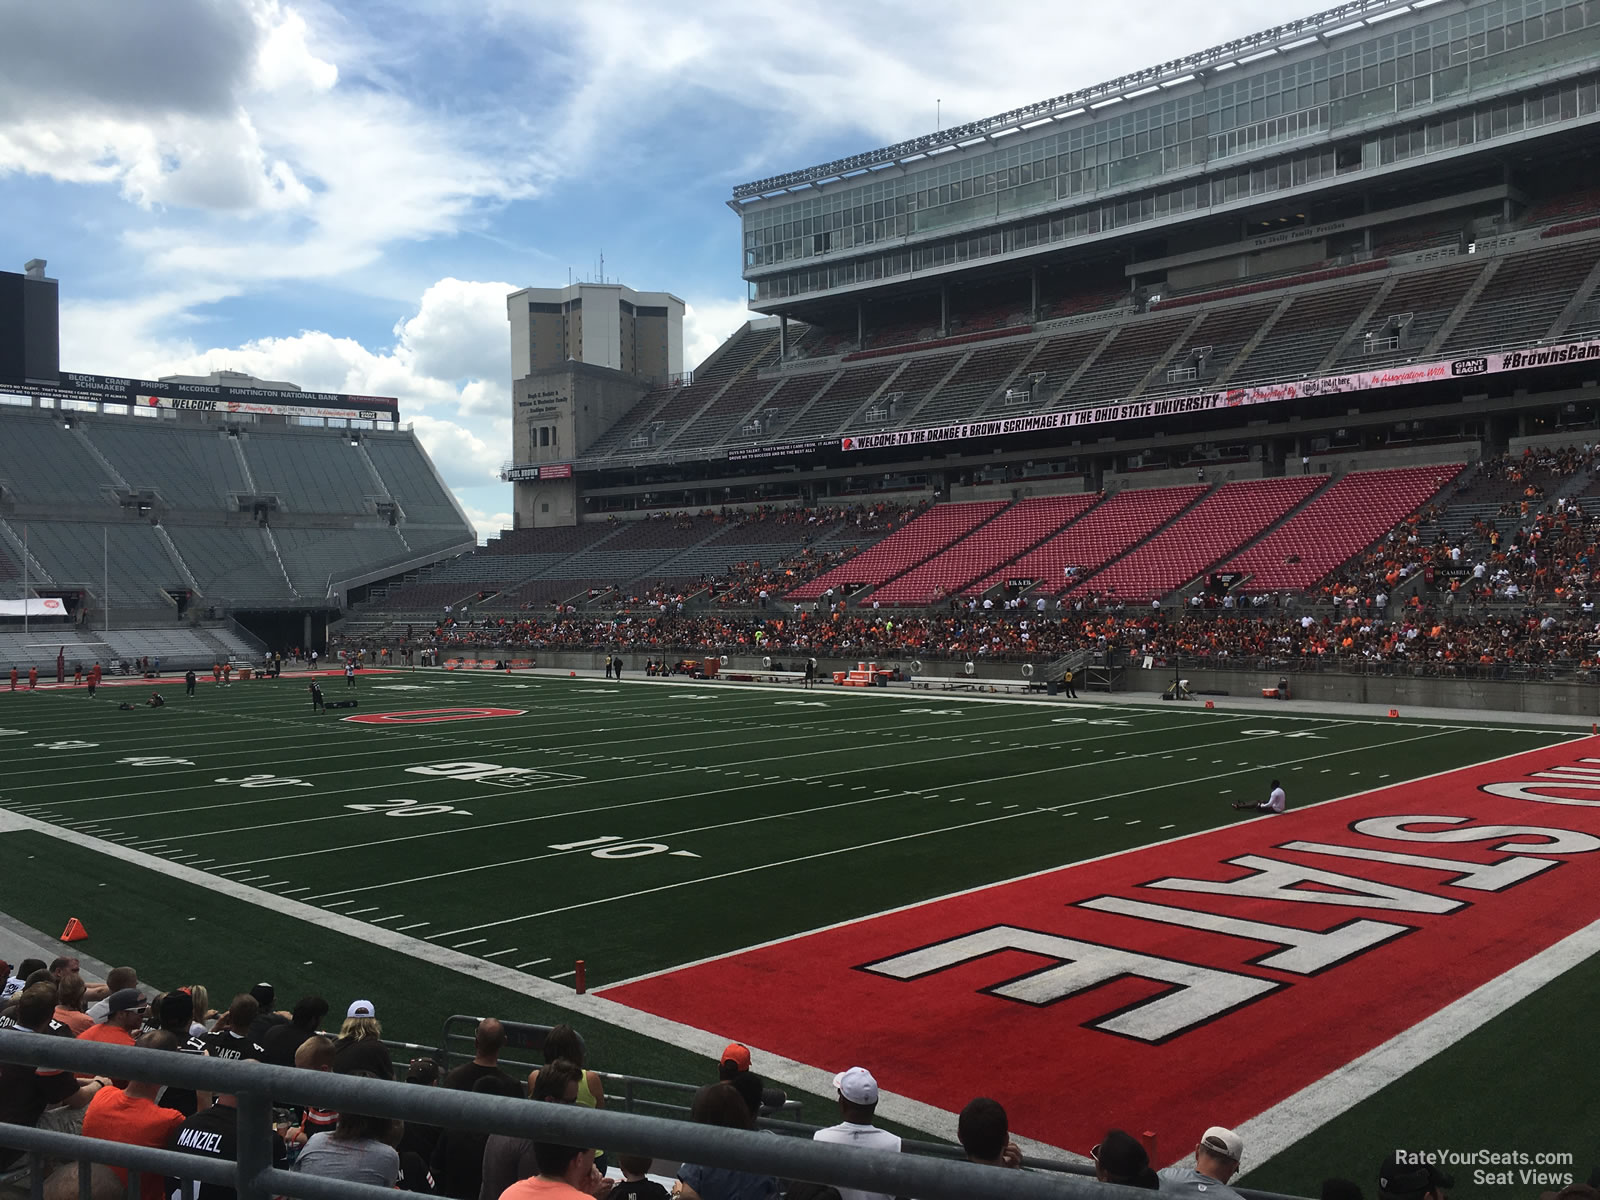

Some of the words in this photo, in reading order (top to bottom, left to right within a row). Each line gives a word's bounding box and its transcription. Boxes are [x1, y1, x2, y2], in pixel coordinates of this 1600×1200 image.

[1291, 229, 1313, 239] Family
[1502, 343, 1600, 370] #BrownsCam
[1454, 359, 1485, 370] GIANT
[1455, 365, 1485, 376] EAGLE
[69, 373, 95, 384] BLOCH
[1381, 369, 1425, 383] Association
[1427, 365, 1445, 377] With
[75, 381, 126, 393] SCHUMAKER
[105, 377, 131, 388] CRANE
[141, 381, 169, 390] PHIPPS
[179, 384, 220, 394] McCORKLE
[230, 387, 278, 398] HUNTINGTON
[280, 391, 317, 400] NATIONAL
[318, 394, 338, 402] BANK
[172, 398, 217, 411] WELCOME
[857, 433, 897, 449] WELCOME
[898, 432, 909, 445] TO
[910, 429, 926, 443] THE
[927, 425, 961, 442] ORANGE
[961, 426, 968, 439] &
[969, 421, 1002, 438] BROWN
[1002, 414, 1059, 434] SCRIMMAGE
[1059, 414, 1073, 426] AT
[1074, 410, 1093, 425] THE
[1094, 406, 1119, 423] OHIO
[1120, 402, 1152, 420] STATE
[1153, 393, 1220, 417] UNIVERSITY
[1441, 568, 1471, 577] CAMBRIA
[214, 773, 303, 788] 30
[344, 799, 455, 817] 20
[546, 835, 670, 859] 10
[850, 814, 1600, 1046] STATE
[177, 1127, 223, 1154] MANZIEL
